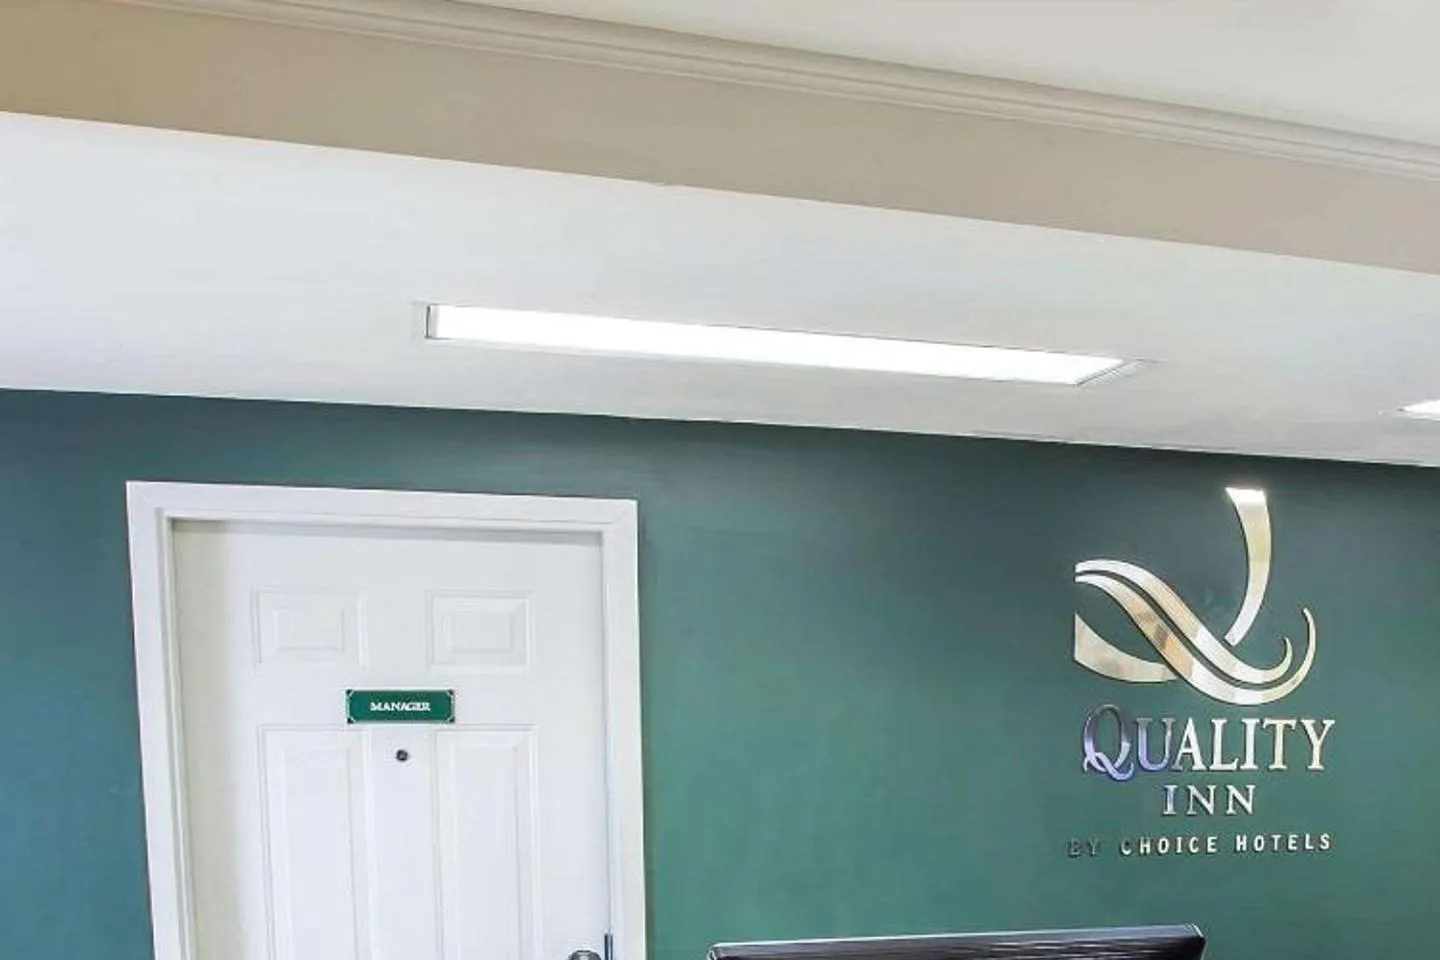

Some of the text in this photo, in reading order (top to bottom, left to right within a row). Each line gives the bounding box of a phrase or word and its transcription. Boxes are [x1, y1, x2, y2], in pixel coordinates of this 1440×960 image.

[369, 701, 431, 712] MANAGER
[1083, 703, 1336, 781] QUALITY
[1162, 784, 1256, 816] INN
[1067, 832, 1332, 857] BY CHOICE HOTELS
